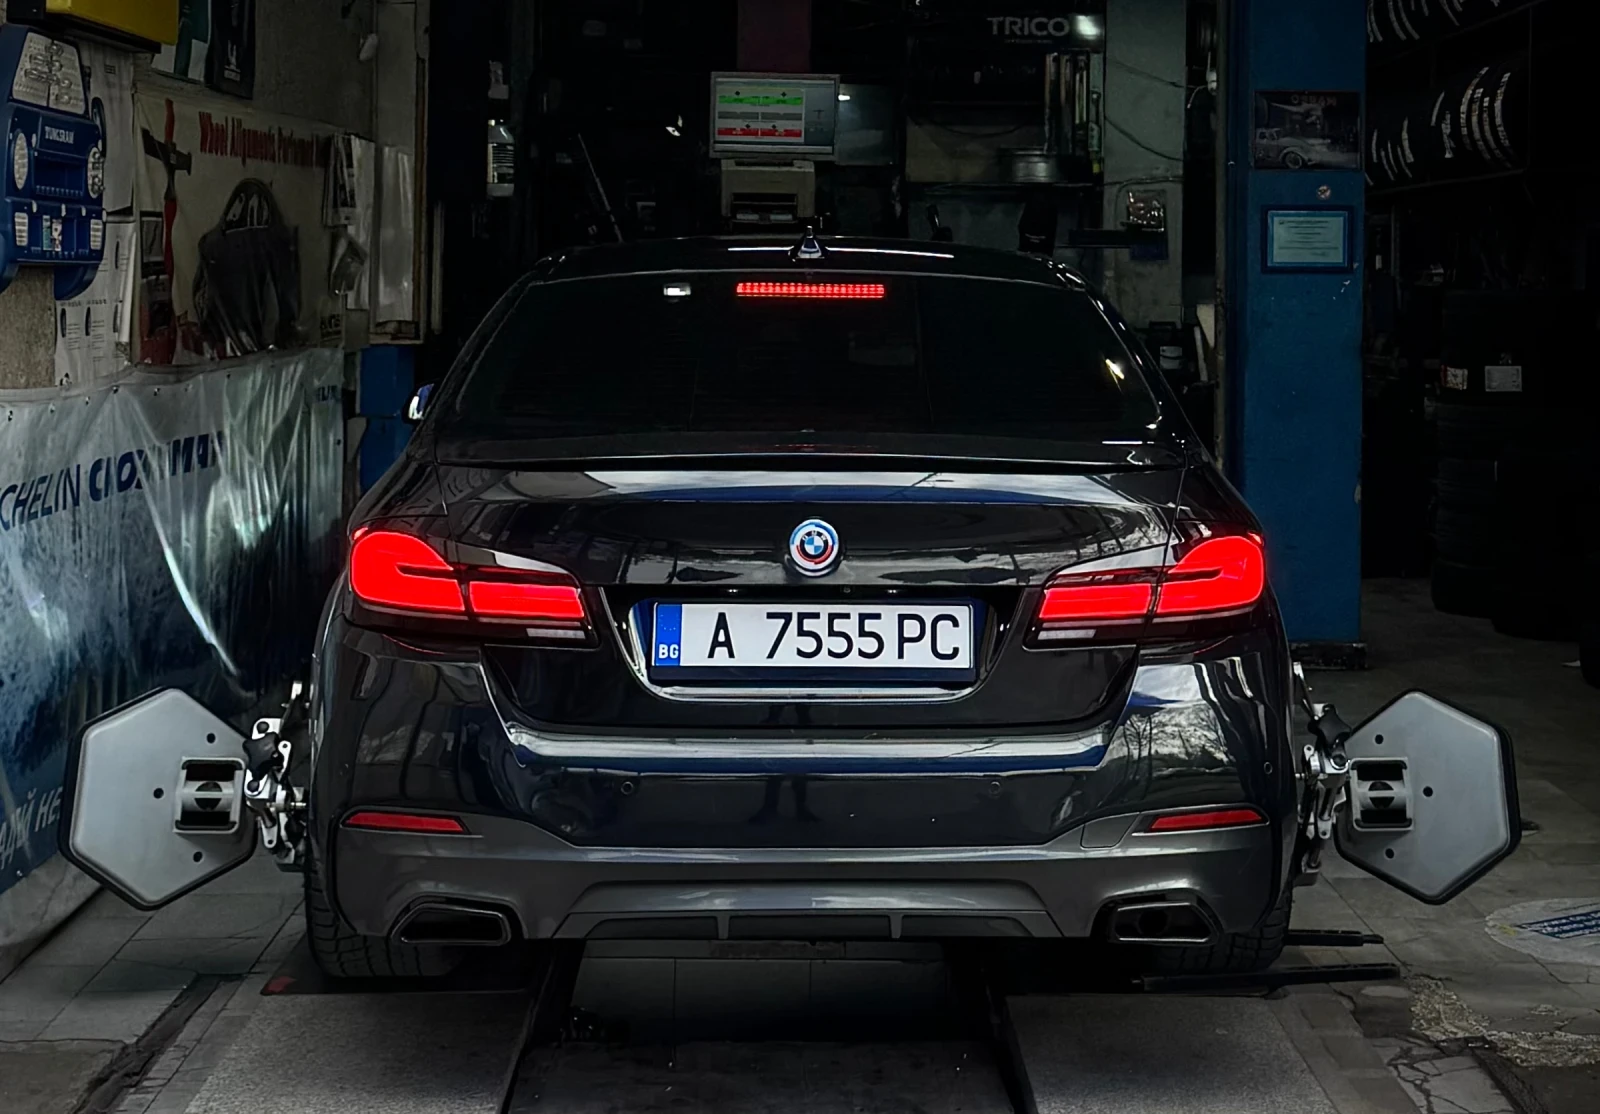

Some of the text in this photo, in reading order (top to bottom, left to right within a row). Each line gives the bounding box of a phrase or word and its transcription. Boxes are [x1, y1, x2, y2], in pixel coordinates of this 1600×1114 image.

[986, 15, 1070, 37] TRICO
[707, 612, 960, 661] A 7555 PC
[658, 643, 679, 659] BG
